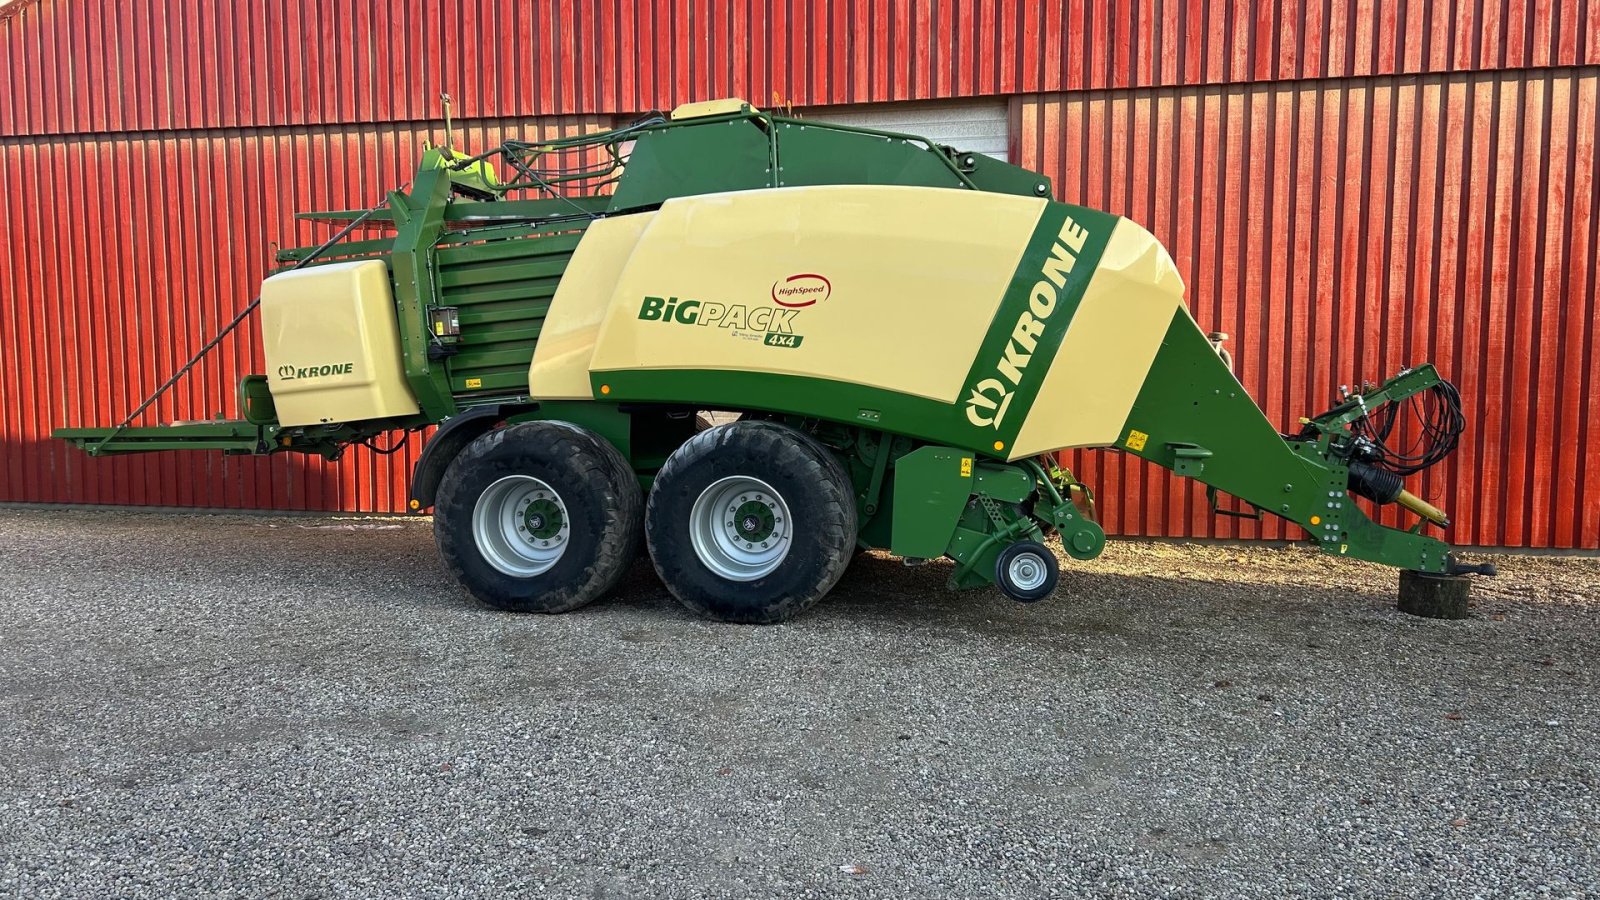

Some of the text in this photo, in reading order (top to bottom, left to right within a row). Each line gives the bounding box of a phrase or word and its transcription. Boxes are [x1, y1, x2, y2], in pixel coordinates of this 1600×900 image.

[778, 285, 824, 296] HighSpeed
[997, 216, 1089, 386] KRONE
[297, 363, 353, 379] KRONE
